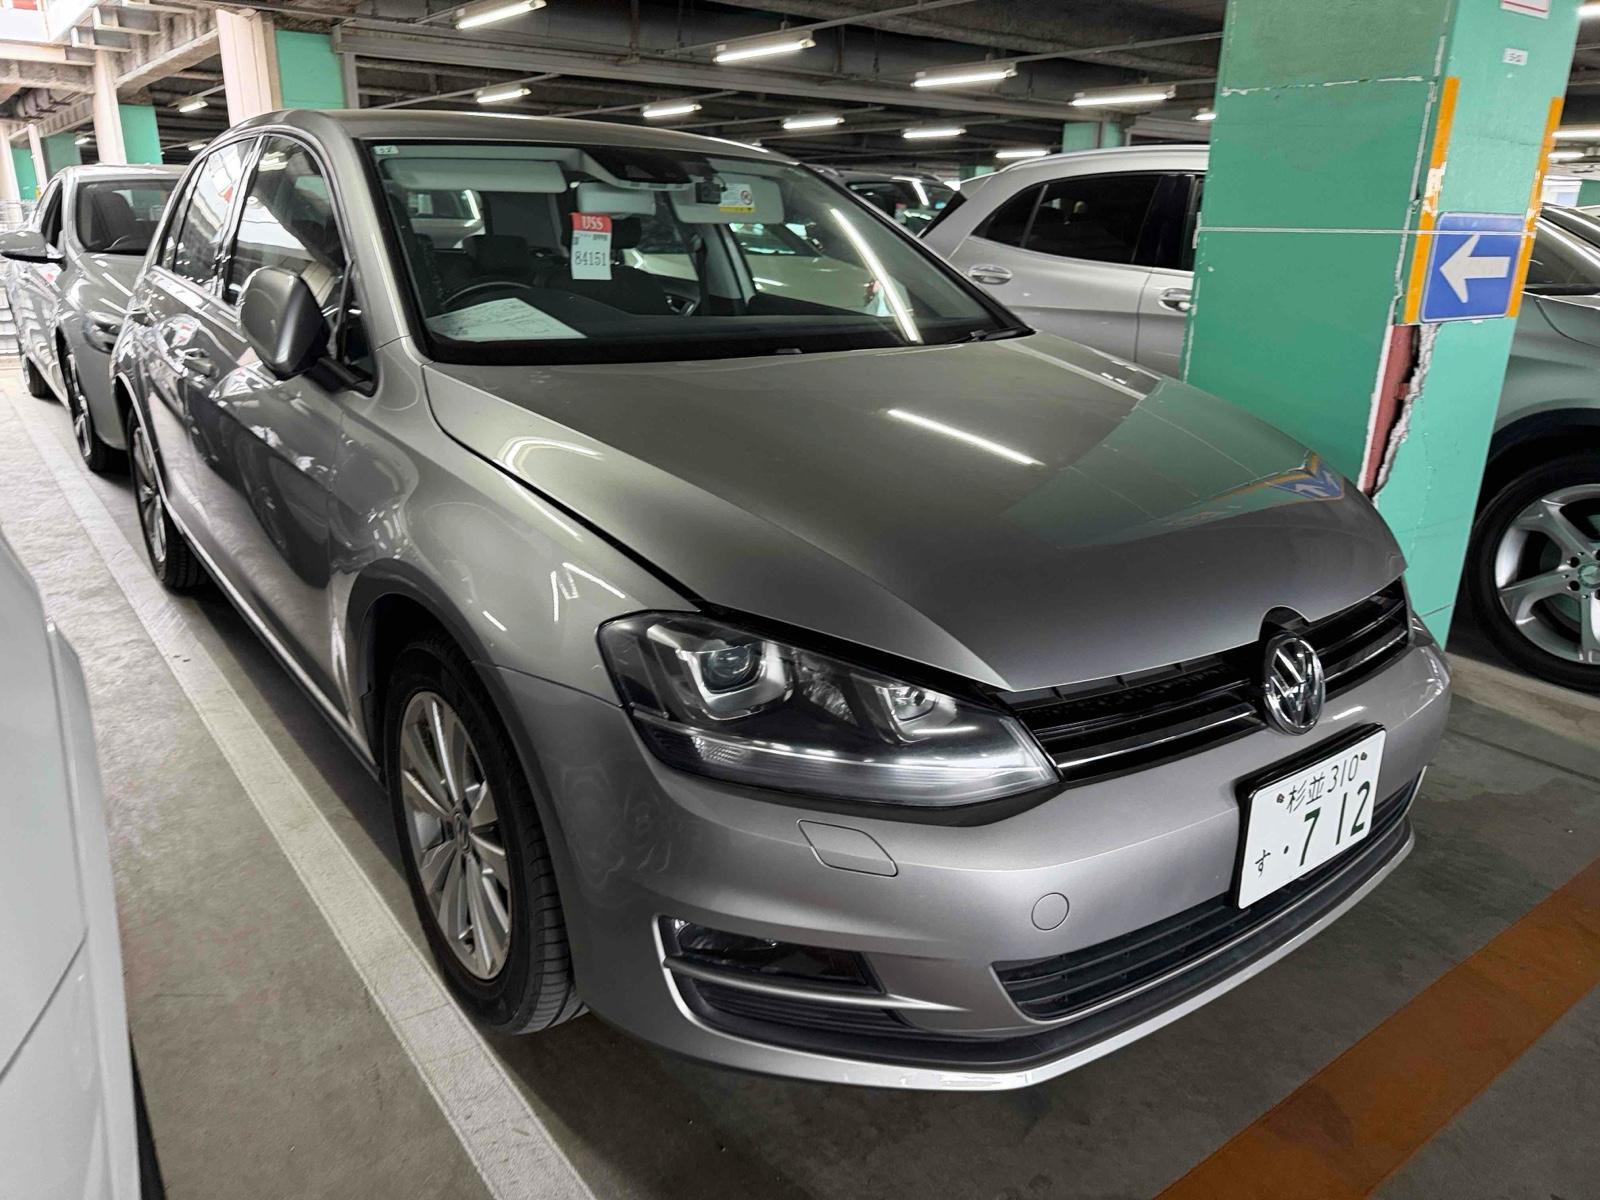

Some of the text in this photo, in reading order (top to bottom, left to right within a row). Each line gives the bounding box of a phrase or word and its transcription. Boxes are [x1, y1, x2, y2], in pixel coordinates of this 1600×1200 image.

[582, 215, 604, 230] USS
[575, 250, 606, 267] 84151
[1286, 754, 1359, 813] 杉並 310
[1254, 849, 1271, 877] す
